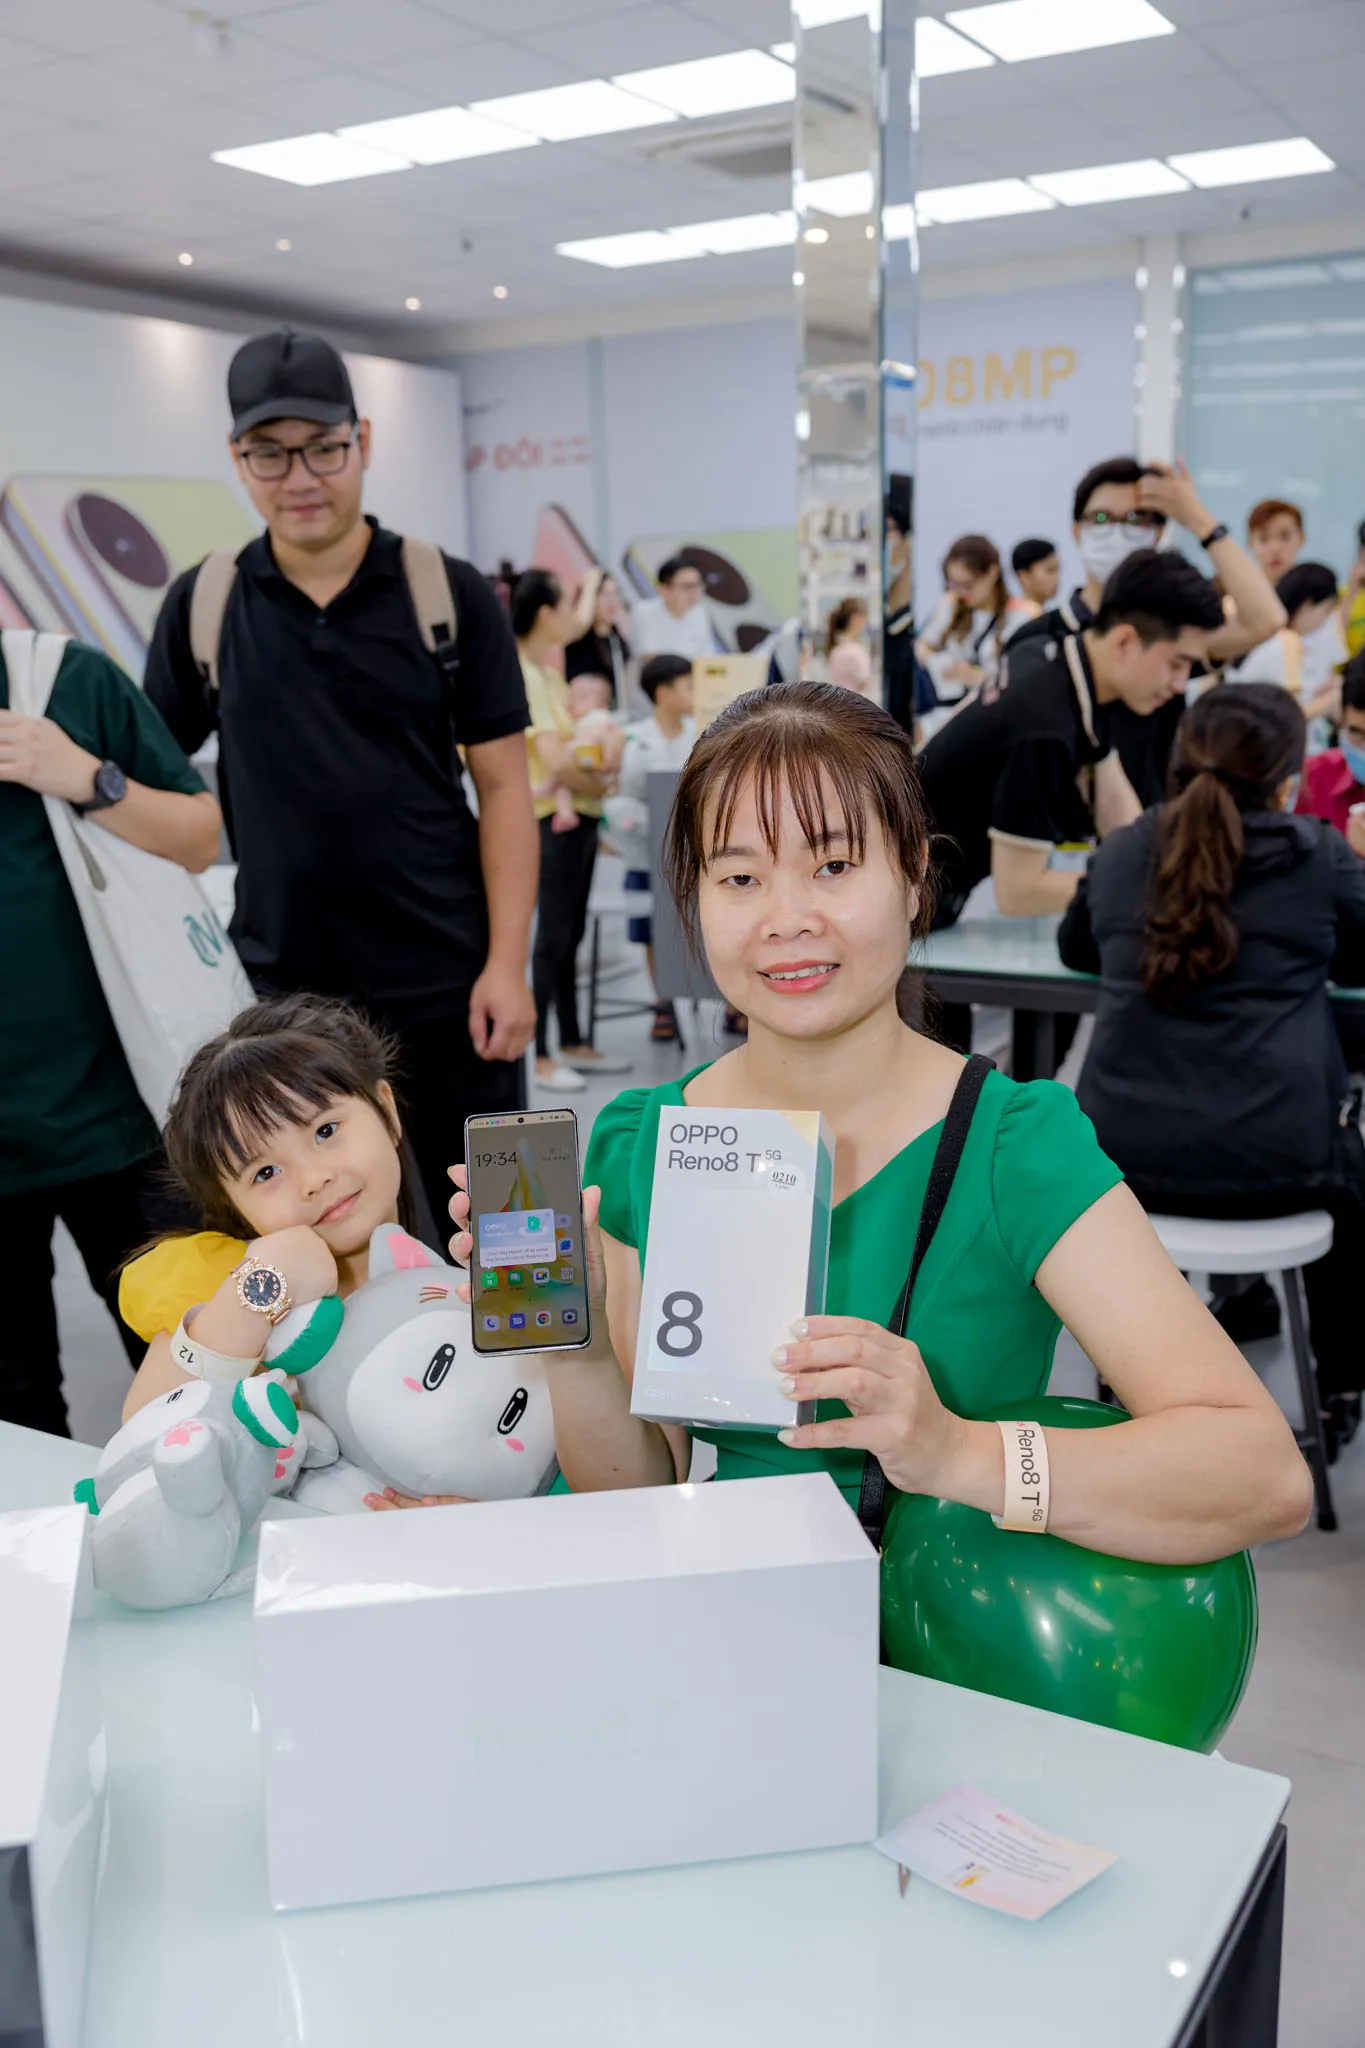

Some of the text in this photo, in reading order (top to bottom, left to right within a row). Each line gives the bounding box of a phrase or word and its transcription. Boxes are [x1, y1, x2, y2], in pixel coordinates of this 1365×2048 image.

[669, 1123, 739, 1146] OPPO
[474, 1151, 518, 1169] 19:34
[668, 1149, 782, 1174] Reno8 T 5G
[772, 1171, 797, 1185] 0210
[656, 1290, 704, 1358] 8
[1016, 1428, 1041, 1485] Reno8
[1021, 1491, 1040, 1506] T
[1031, 1508, 1043, 1522] 5G
